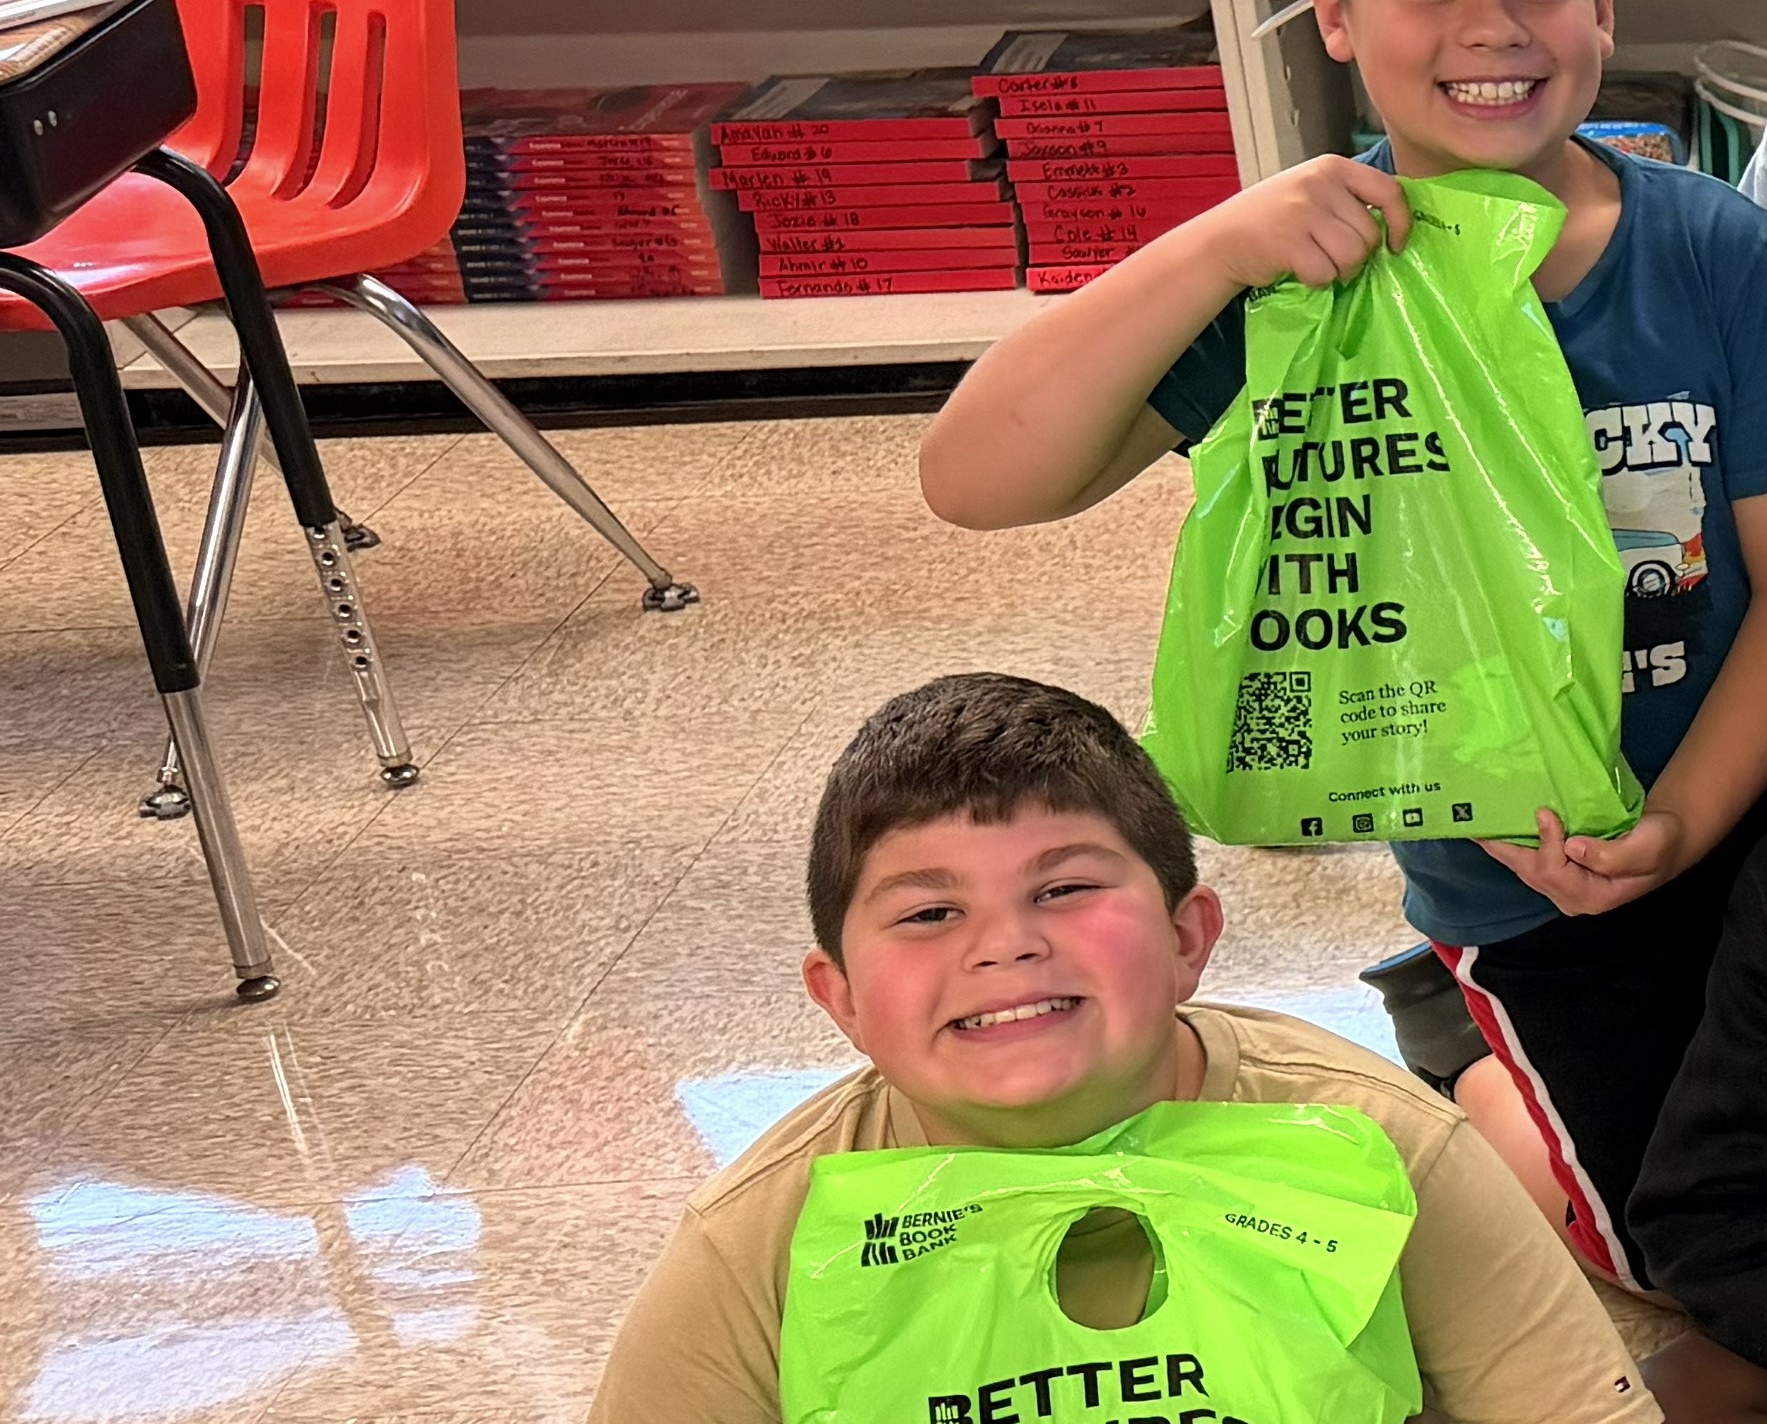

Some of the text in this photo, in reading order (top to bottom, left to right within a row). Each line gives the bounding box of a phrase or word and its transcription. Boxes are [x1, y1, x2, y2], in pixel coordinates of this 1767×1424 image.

[1328, 782, 1441, 804] Connect with us
[901, 1203, 983, 1229] BERNIE'S
[899, 1223, 957, 1247] BOOK
[1224, 1212, 1339, 1254] GRADES 4 5
[901, 1235, 958, 1261] BANK
